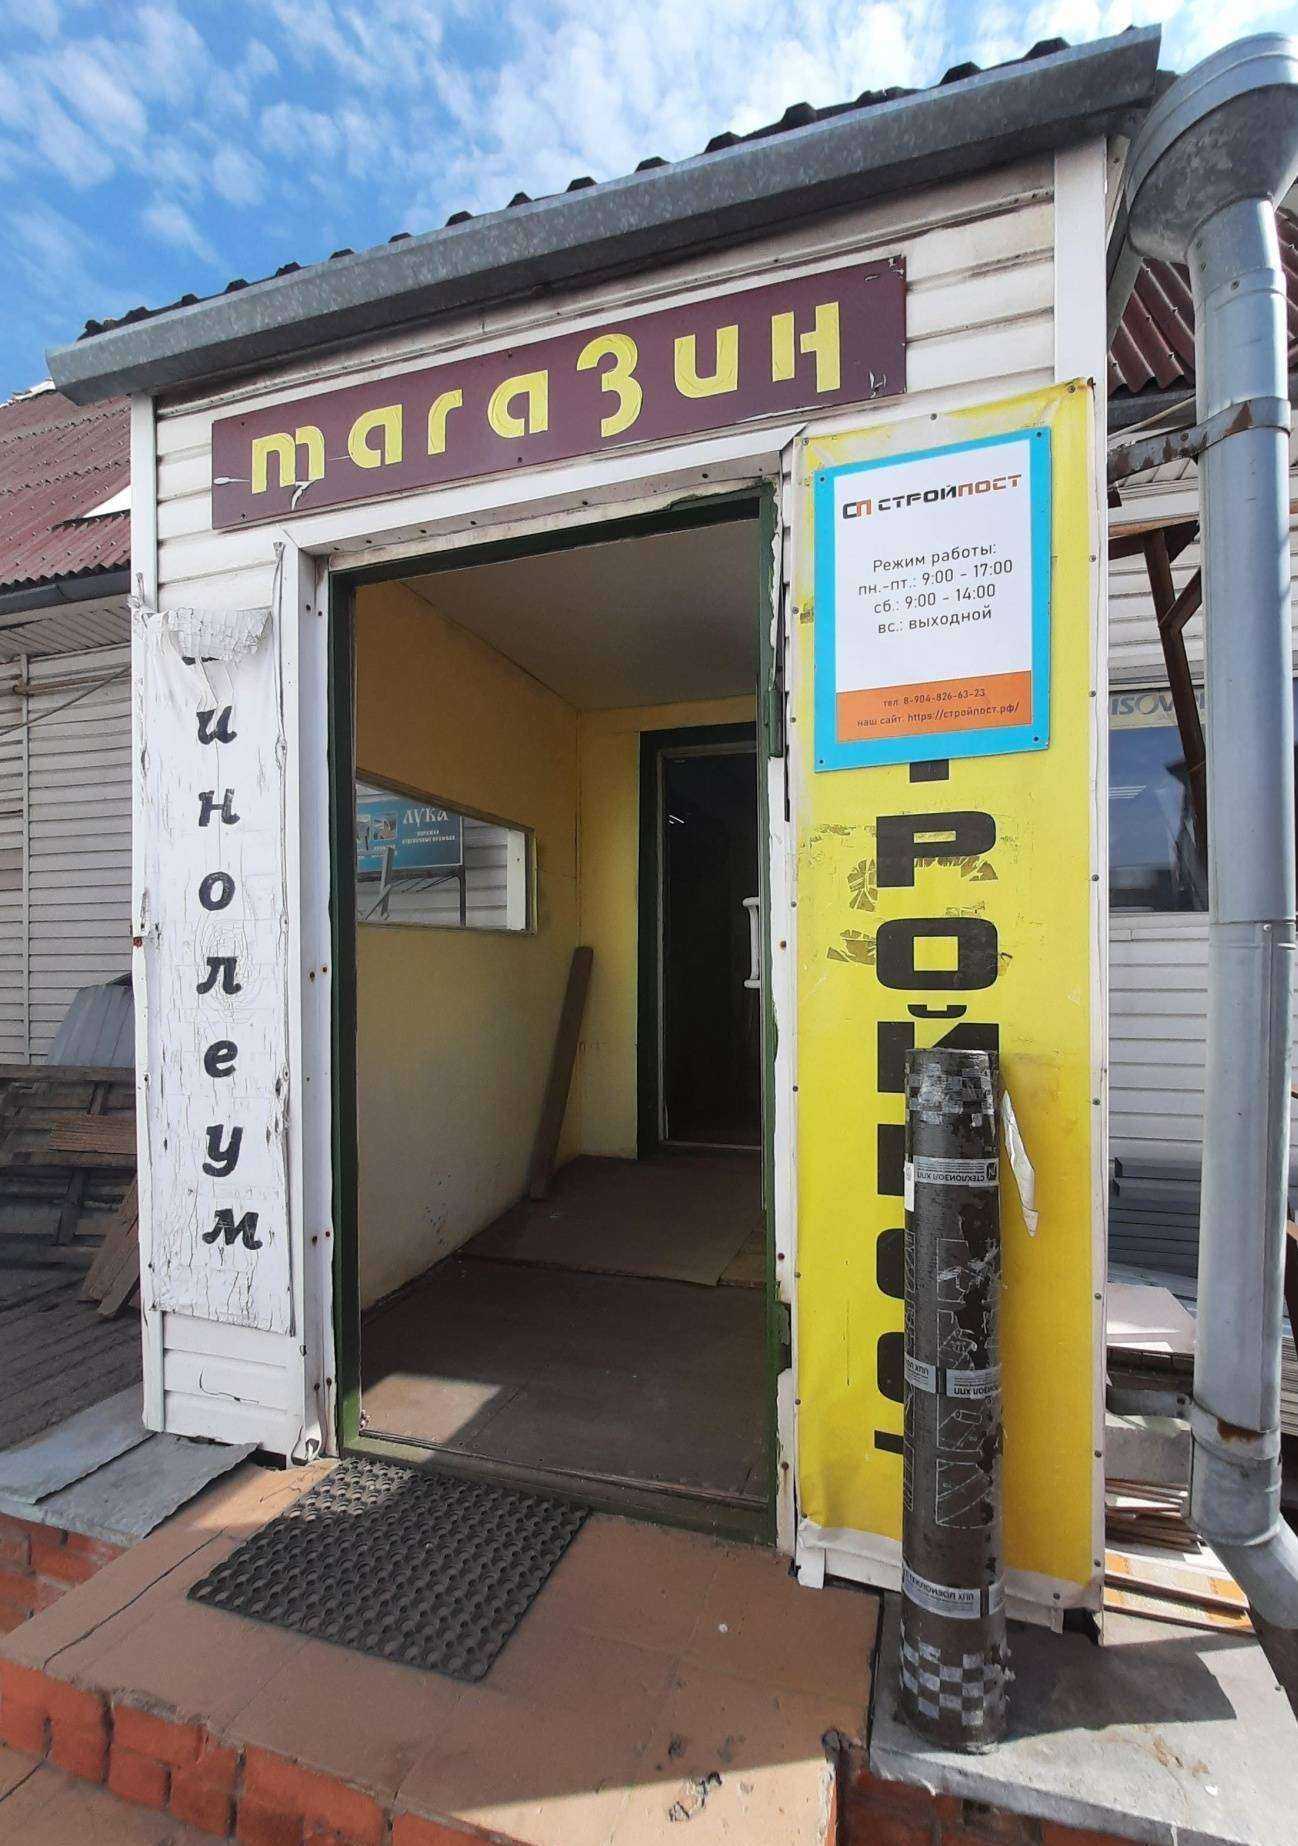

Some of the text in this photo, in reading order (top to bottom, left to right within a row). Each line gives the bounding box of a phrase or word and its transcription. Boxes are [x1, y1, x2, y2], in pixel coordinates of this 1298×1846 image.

[878, 474, 1022, 511] СТРОЙПОСТ
[873, 544, 997, 573] Режим работы:
[922, 569, 954, 586] 9:00
[974, 559, 1013, 578] 17:00
[874, 601, 900, 614] сб.:
[905, 592, 936, 610] 9:00
[956, 584, 996, 602] 14:00
[878, 605, 992, 634] вс.: выходной
[857, 718, 878, 727] наш
[181, 657, 262, 1250] инолеум
